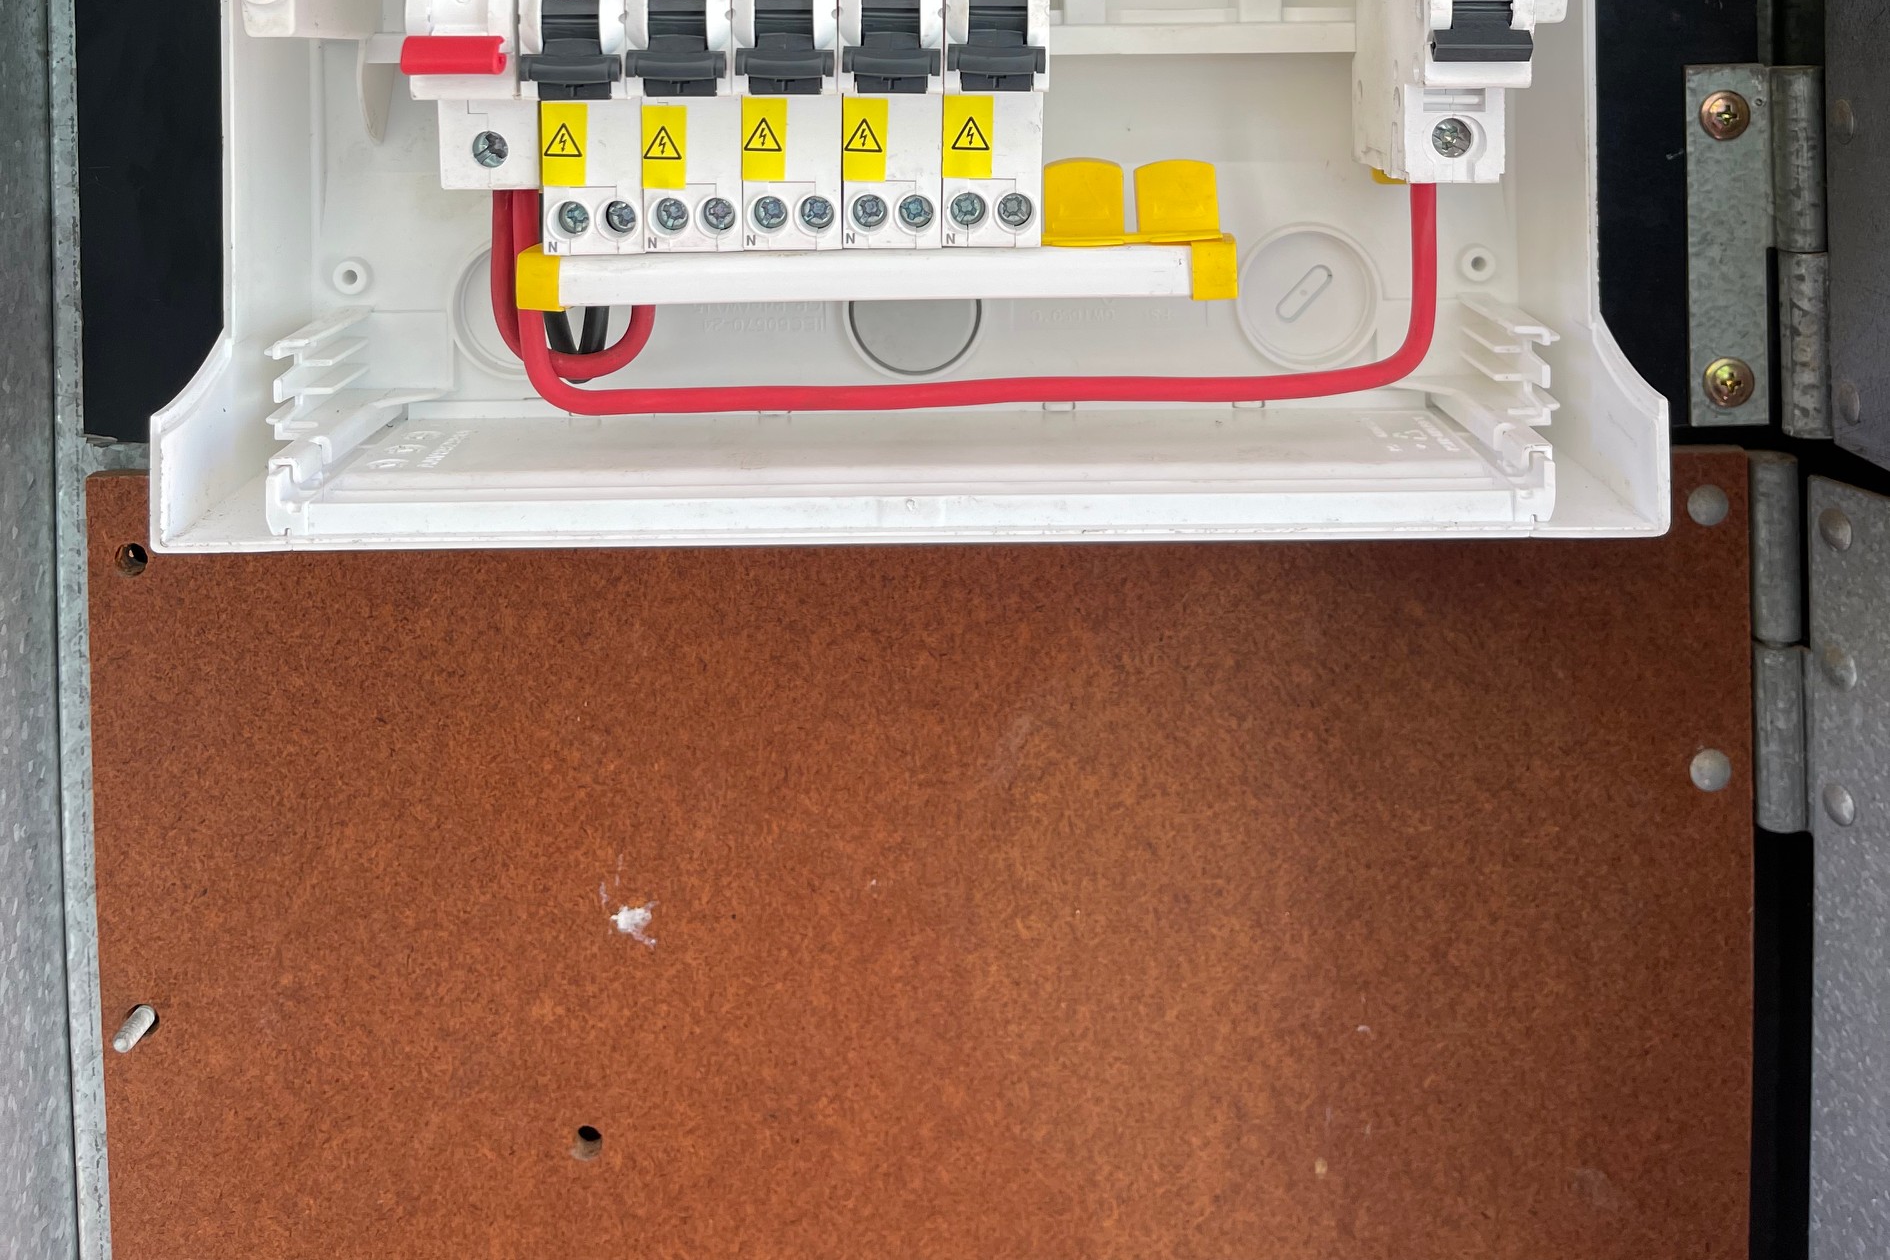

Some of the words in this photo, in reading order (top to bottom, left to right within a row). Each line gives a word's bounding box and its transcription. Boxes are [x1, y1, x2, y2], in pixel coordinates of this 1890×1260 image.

[648, 237, 657, 248] N
[746, 235, 756, 246] N
[846, 233, 855, 244] N
[946, 233, 955, 244] N
[549, 241, 557, 252] N
